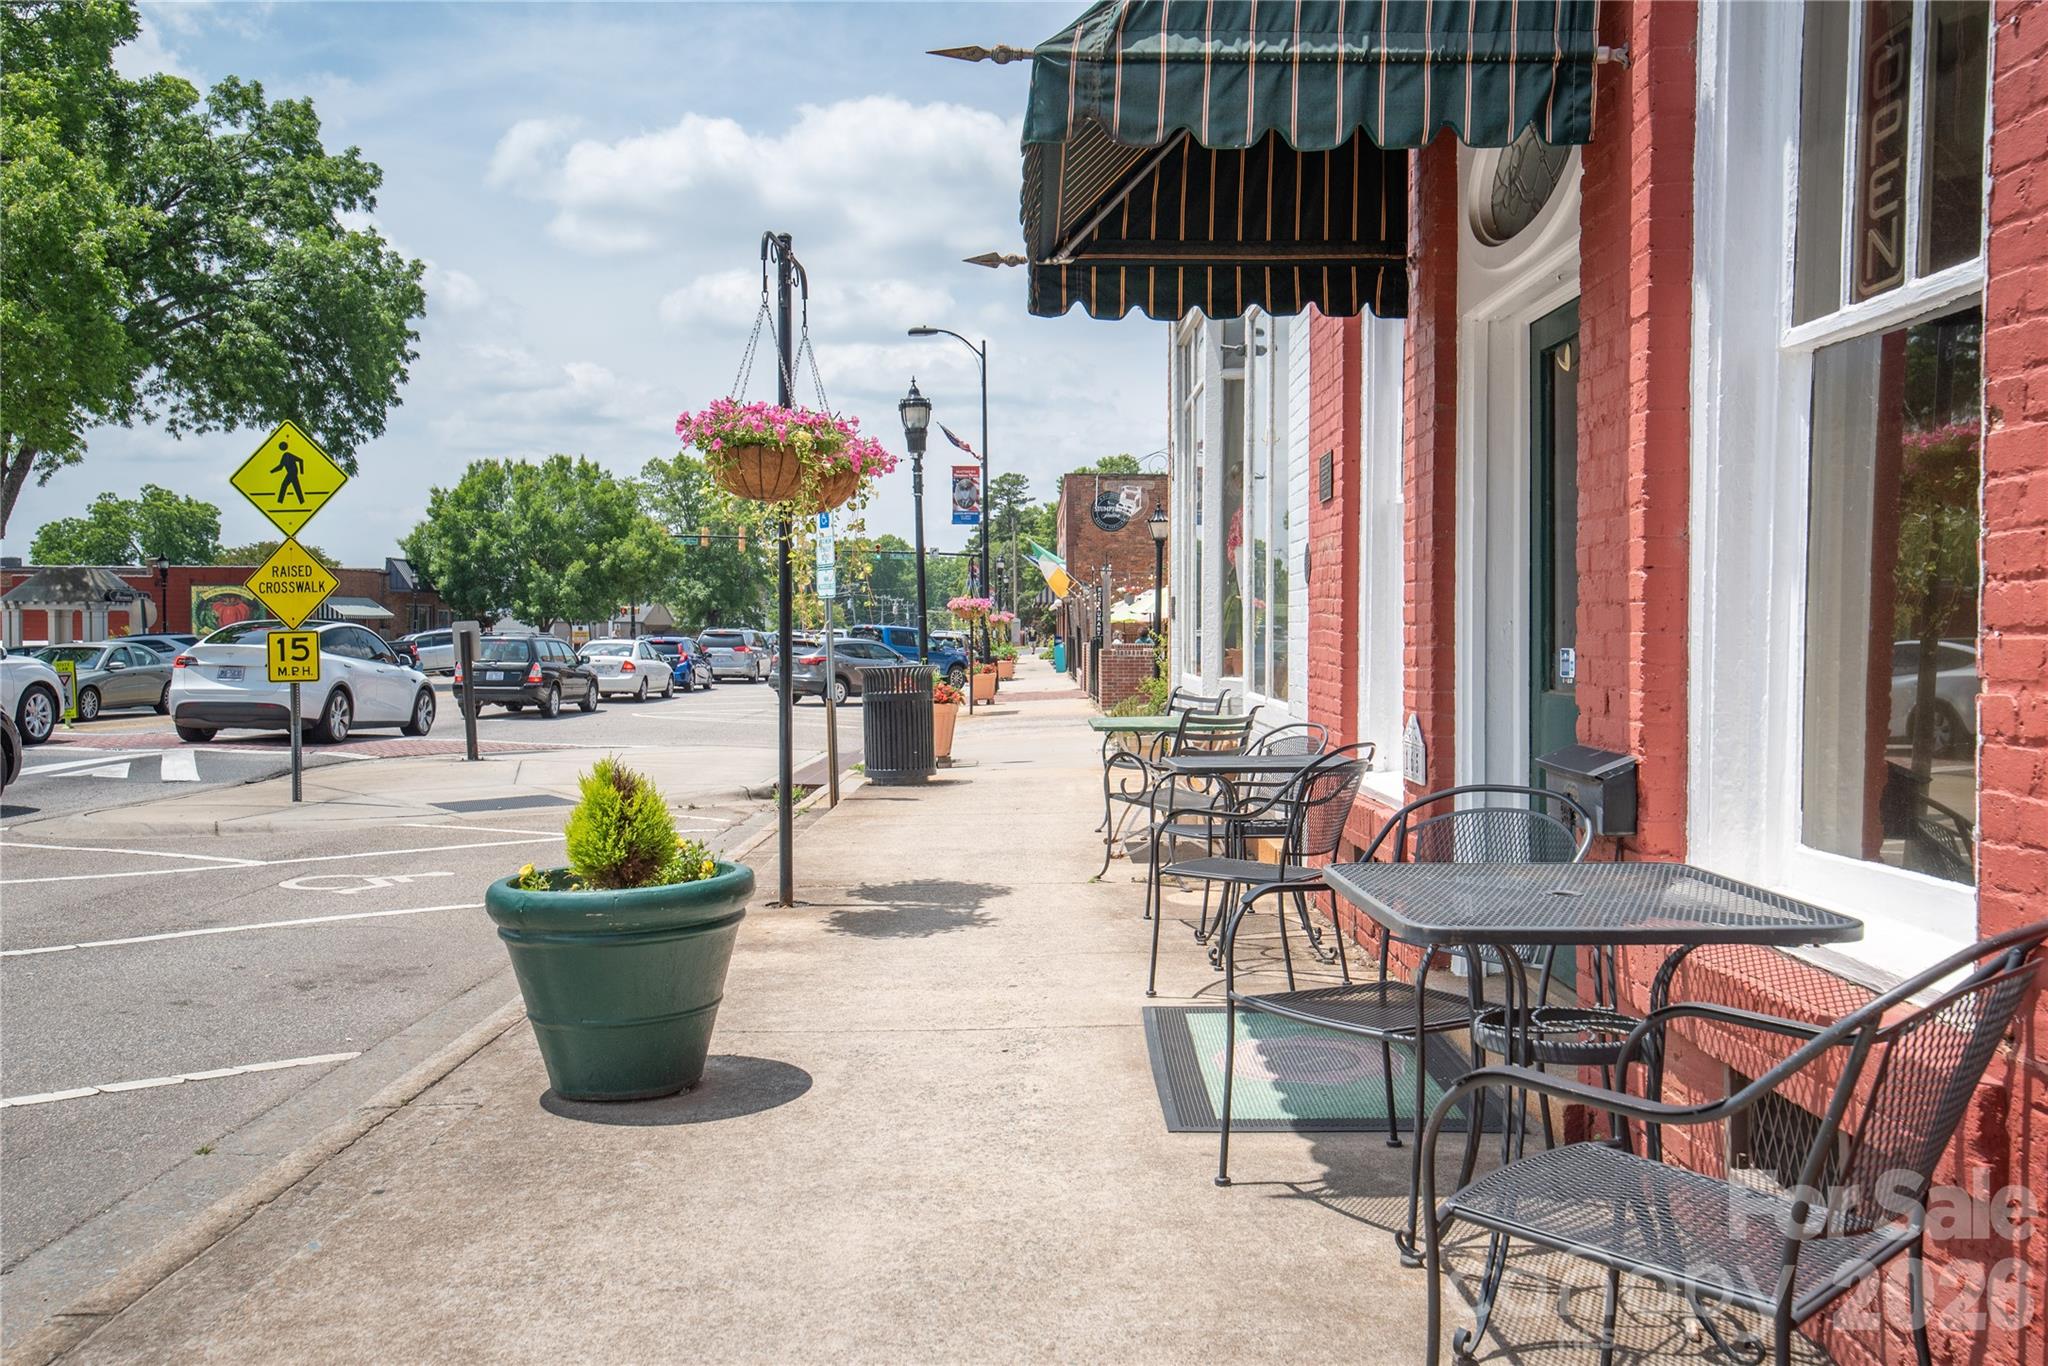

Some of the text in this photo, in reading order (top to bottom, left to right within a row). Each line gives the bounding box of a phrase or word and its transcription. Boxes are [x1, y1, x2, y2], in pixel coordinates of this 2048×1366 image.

[1866, 42, 1904, 280] OPEN
[272, 565, 313, 578] RAISED
[258, 581, 326, 594] CROSSWALK
[276, 637, 310, 662] 15
